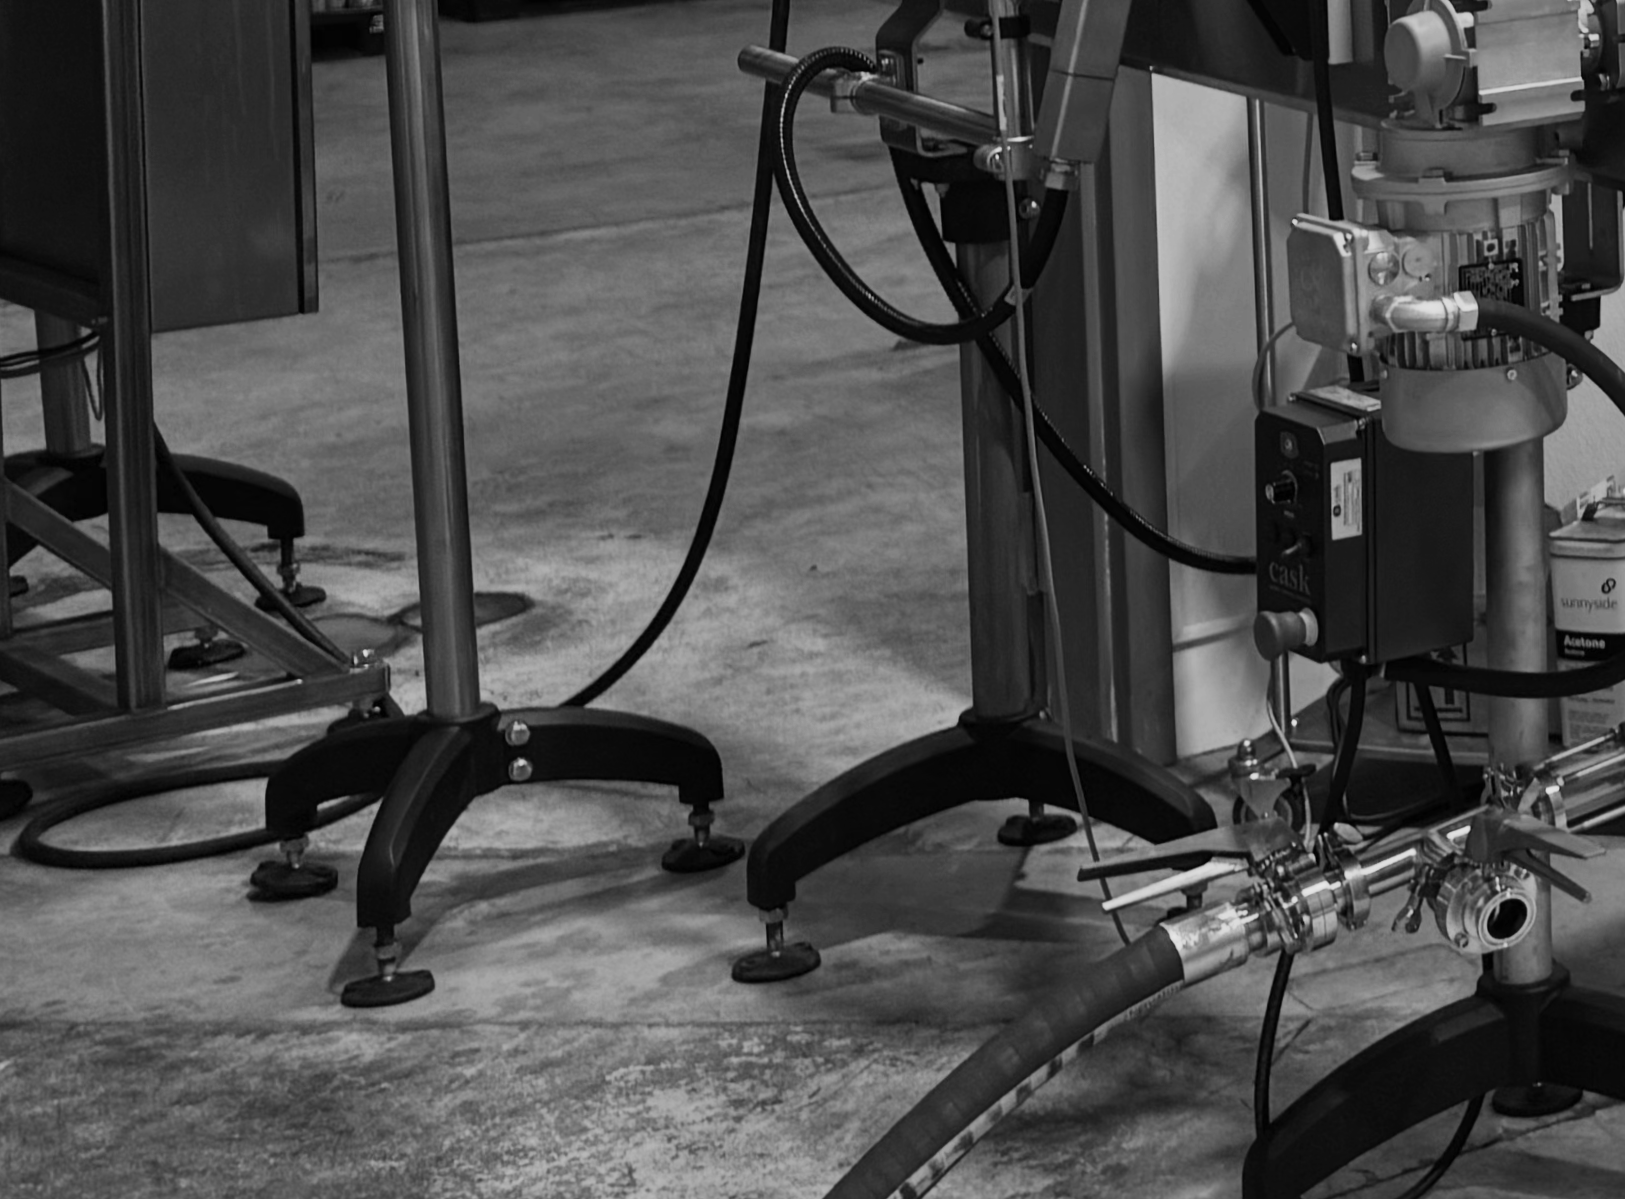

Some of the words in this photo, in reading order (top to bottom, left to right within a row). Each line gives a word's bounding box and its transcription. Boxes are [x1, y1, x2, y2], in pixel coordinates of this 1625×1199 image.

[1268, 561, 1311, 596] cask
[1561, 597, 1618, 614] sunnyside
[1563, 634, 1606, 649] Acetone
